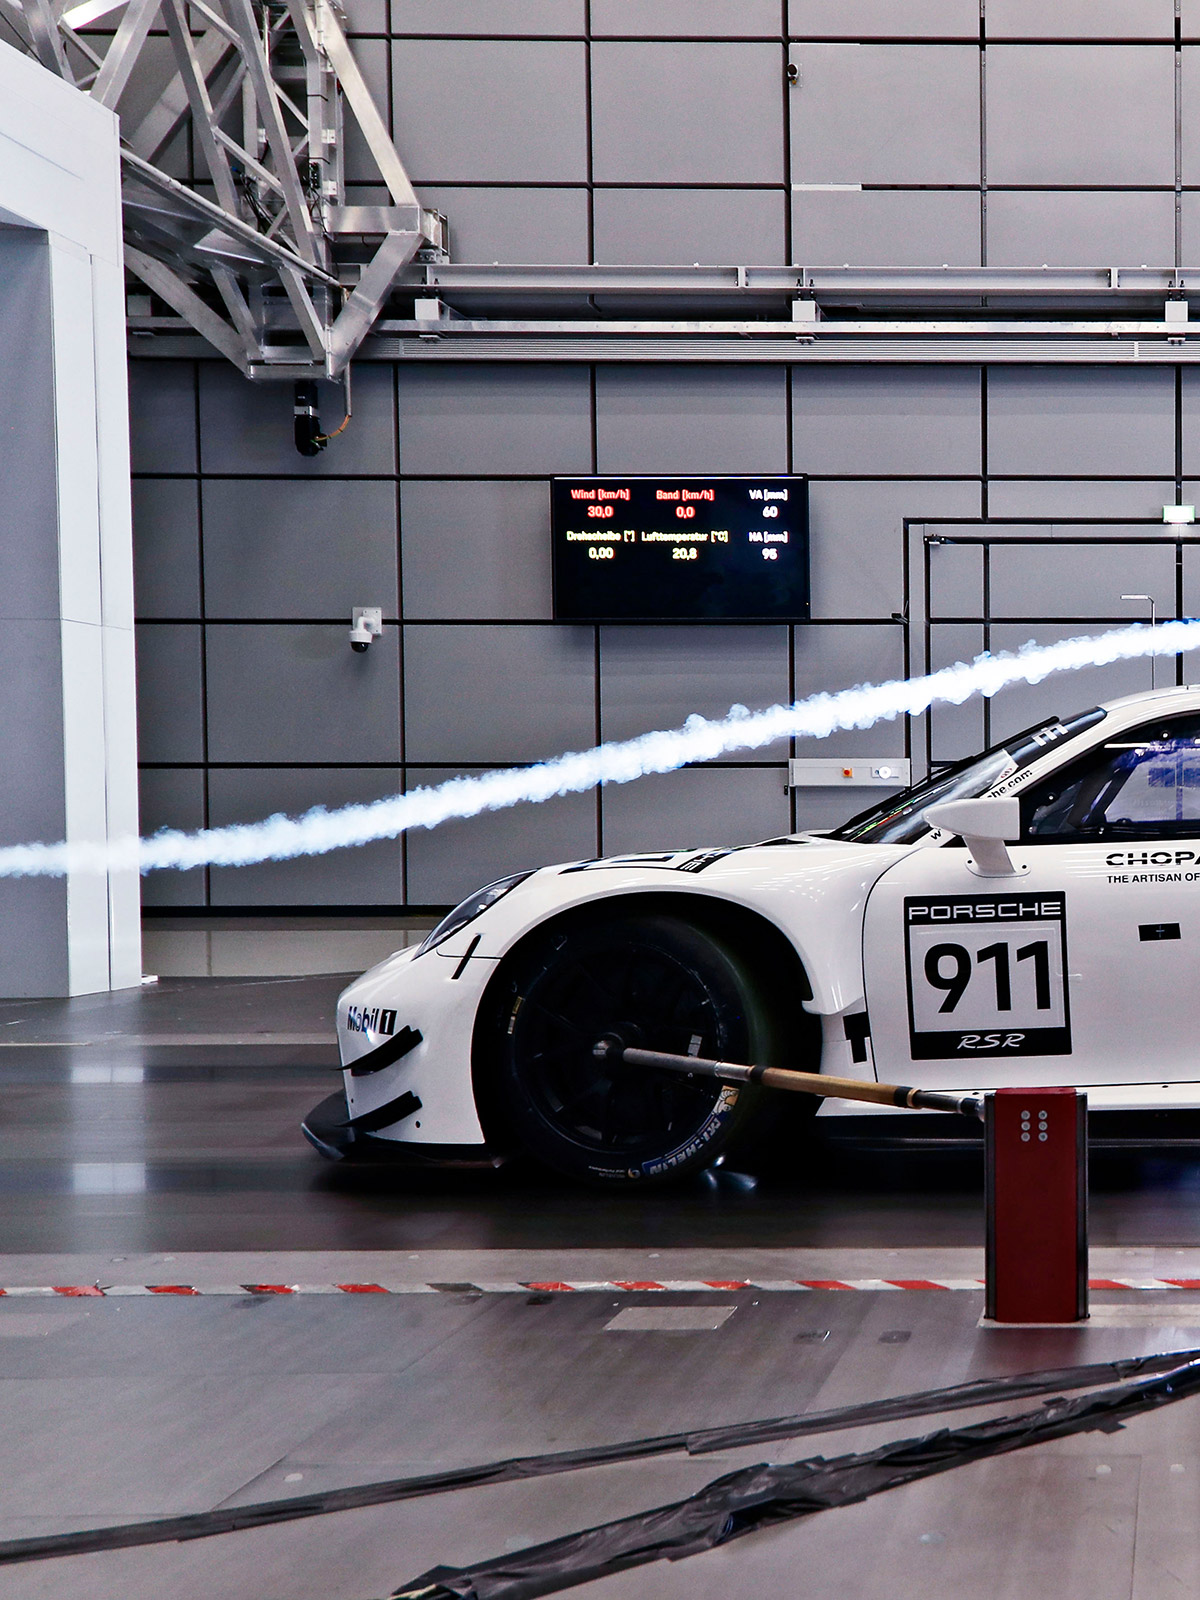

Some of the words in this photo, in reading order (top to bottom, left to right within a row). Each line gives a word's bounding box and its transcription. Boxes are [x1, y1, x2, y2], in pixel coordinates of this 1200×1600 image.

[571, 489, 596, 499] Wind
[598, 489, 631, 501] [km/h]
[656, 490, 680, 500] Band
[682, 489, 715, 501] [km/h]
[748, 489, 763, 500] VA
[587, 505, 614, 518] 30,0
[676, 506, 695, 518] 0,0
[762, 505, 779, 518] 60
[588, 546, 614, 560] 0,00
[672, 547, 698, 560] 20,8
[1107, 875, 1129, 884] THE
[1132, 873, 1182, 883] ARTISAN
[1185, 872, 1200, 882] OF
[908, 901, 1062, 920] PORSCHE
[923, 939, 1052, 1014] 911
[347, 1006, 380, 1033] Mobil
[957, 1033, 1026, 1050] RSR
